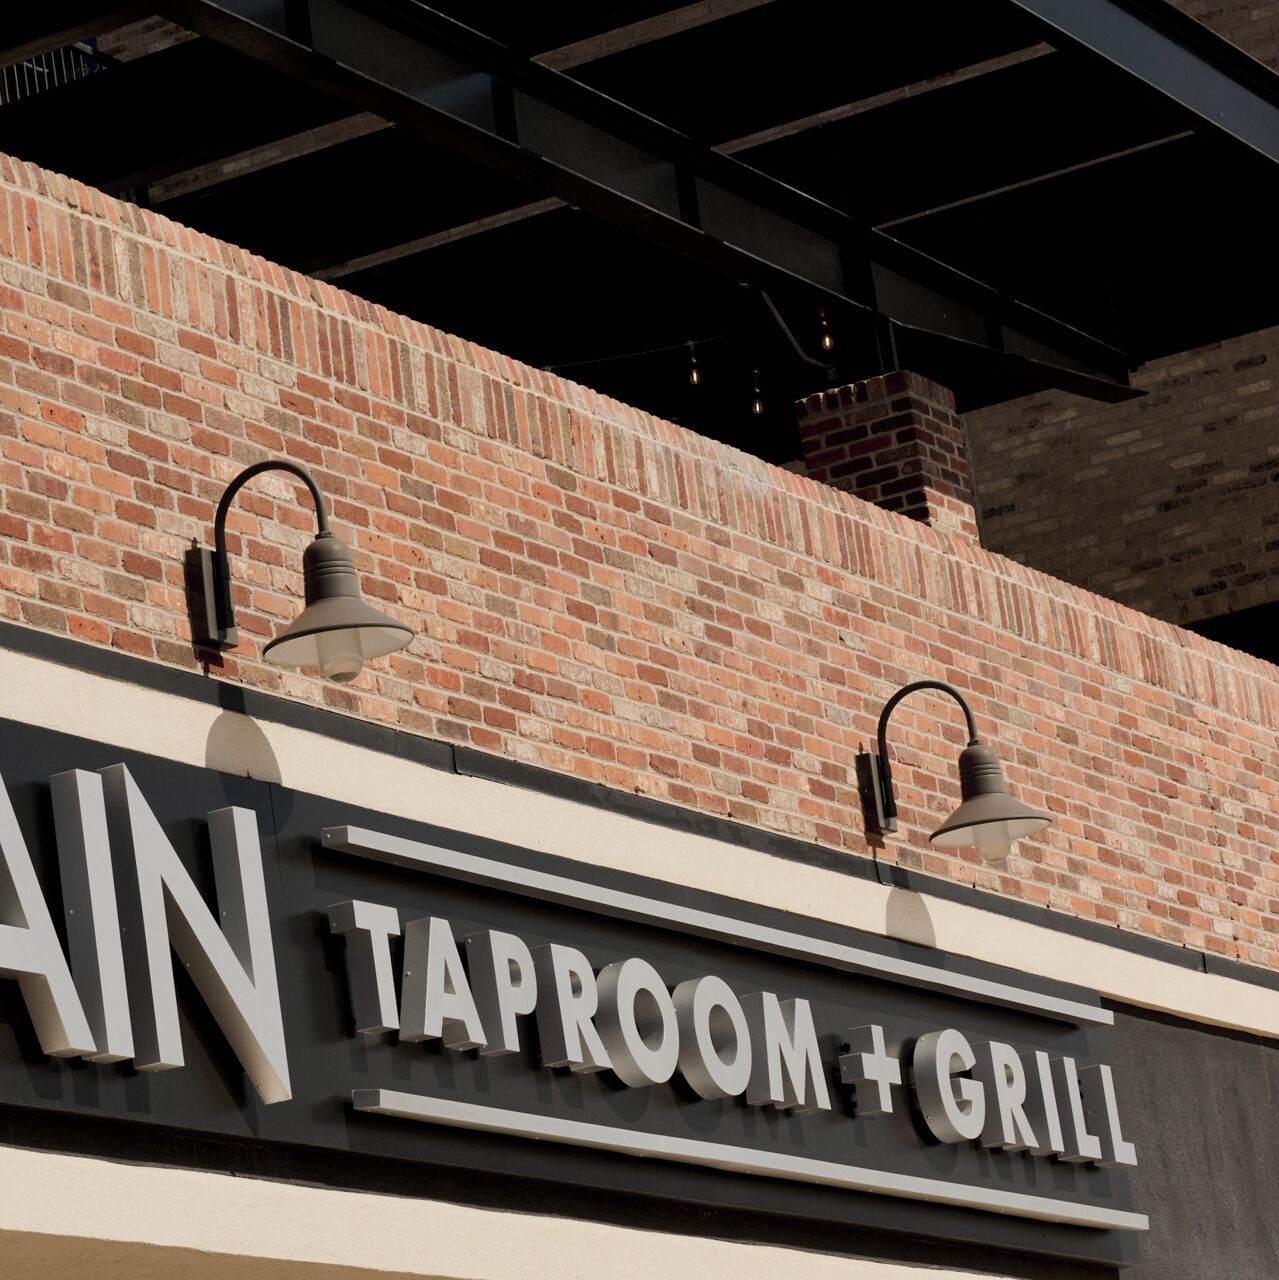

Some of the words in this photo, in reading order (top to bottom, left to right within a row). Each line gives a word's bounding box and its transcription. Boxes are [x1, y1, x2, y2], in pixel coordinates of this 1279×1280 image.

[329, 900, 831, 1114] TAPROOM
[840, 1025, 900, 1116] +
[914, 1028, 1138, 1168] GRILL
